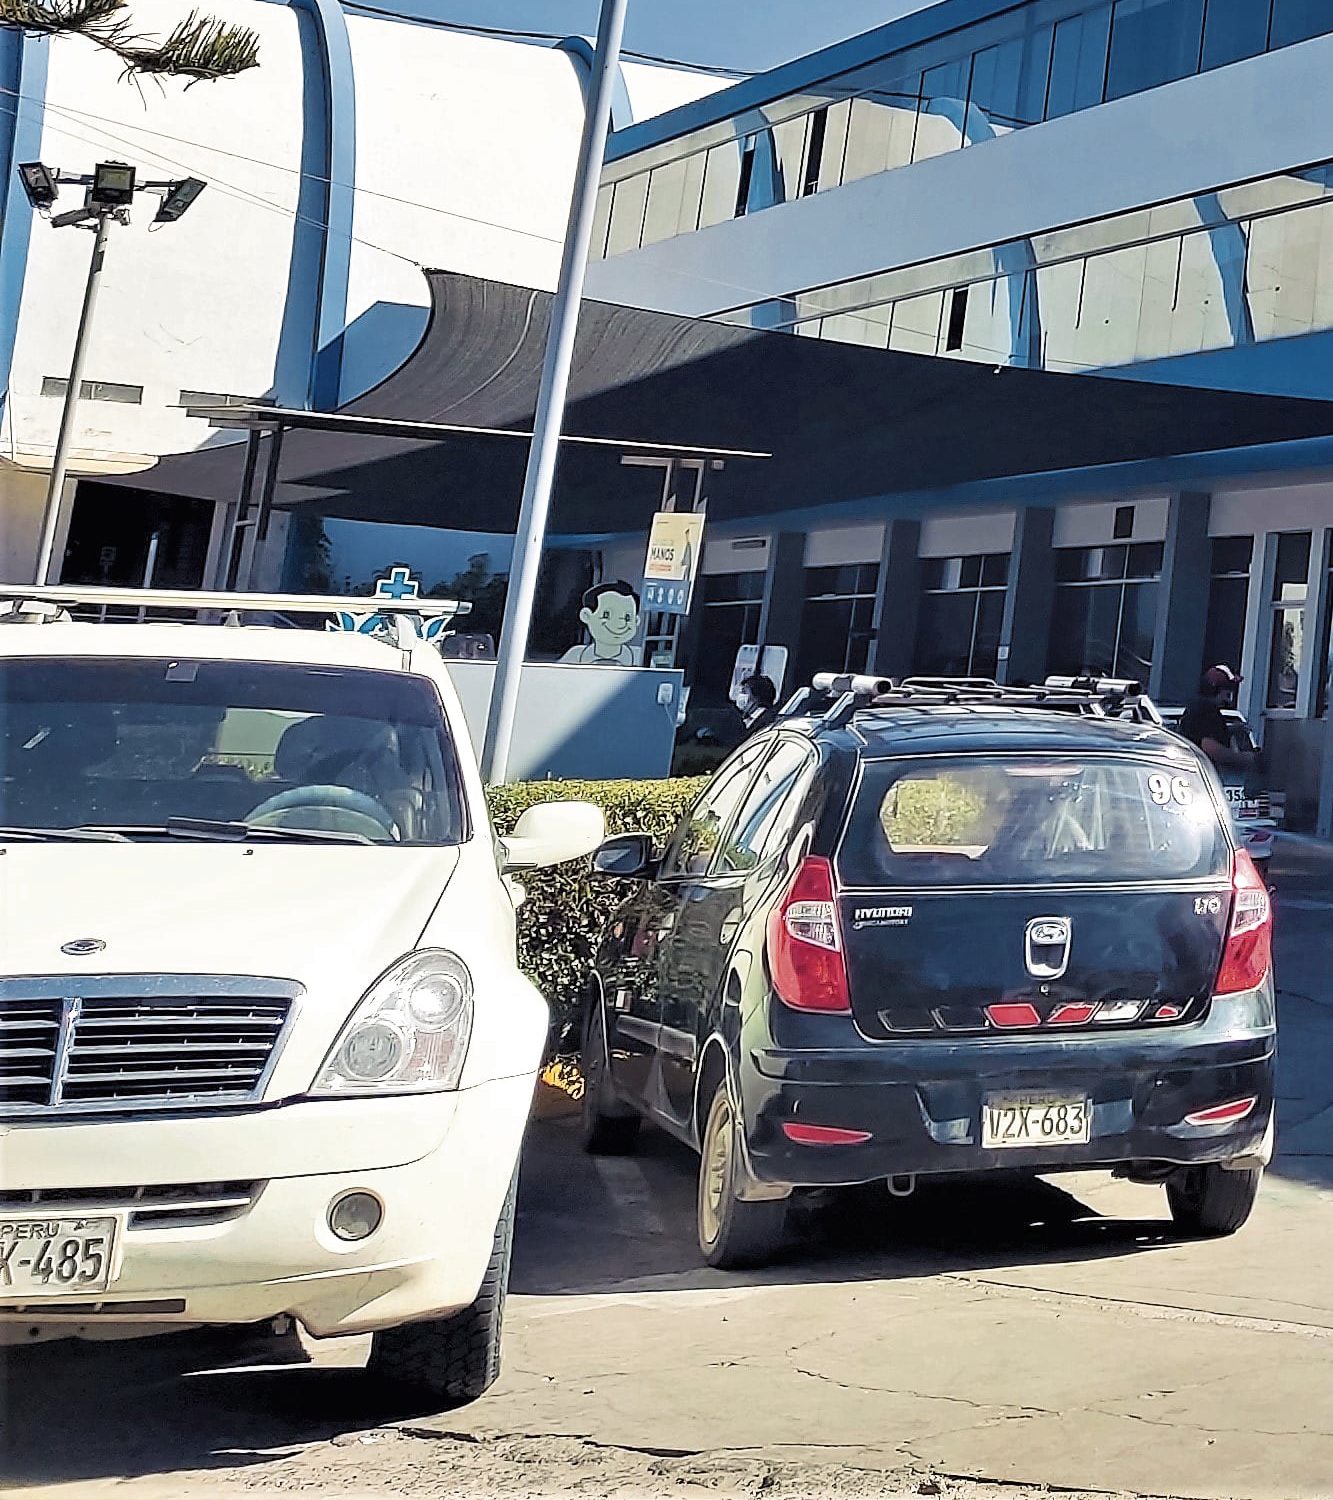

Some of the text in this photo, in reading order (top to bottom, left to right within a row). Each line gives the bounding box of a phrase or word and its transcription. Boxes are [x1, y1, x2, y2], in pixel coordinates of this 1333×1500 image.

[1147, 773, 1194, 806] 96
[988, 1104, 1083, 1139] V2X-683
[1, 1222, 60, 1239] PERU
